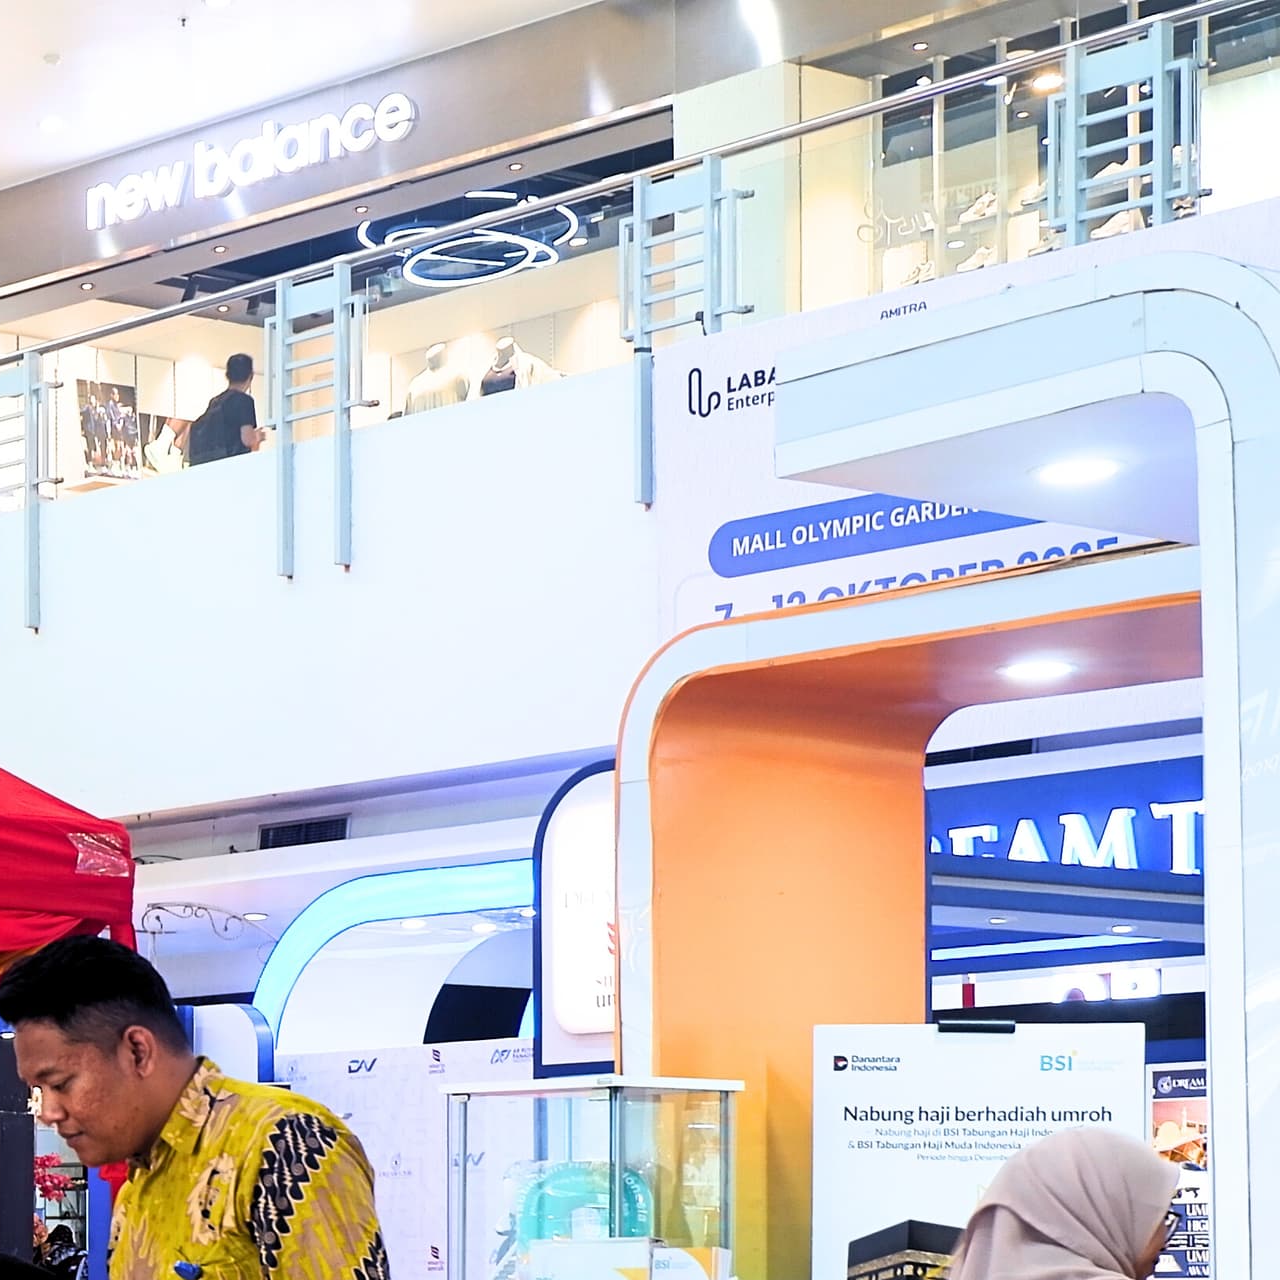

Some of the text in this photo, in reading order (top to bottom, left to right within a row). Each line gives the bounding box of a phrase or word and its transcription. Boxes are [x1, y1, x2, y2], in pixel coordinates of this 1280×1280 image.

[86, 91, 418, 231] new balance
[880, 301, 928, 320] AMITRA
[731, 529, 786, 557] MALL
[791, 510, 885, 546] OLYMPIC
[851, 1055, 901, 1065] Danantara
[851, 1063, 898, 1073] Indonesia
[1039, 1055, 1073, 1072] BSI
[843, 1105, 1113, 1126] Nabung haji berhadiah umroh
[875, 1127, 912, 1139] Nabung
[913, 1127, 931, 1138] haji
[943, 1128, 960, 1137] BSI
[962, 1127, 1008, 1139] Tabungan
[1010, 1127, 1031, 1139] Haji
[857, 1140, 874, 1149] BSI
[876, 1140, 922, 1151] Tabungan
[923, 1140, 943, 1151] Haji
[945, 1140, 972, 1149] Muda
[974, 1140, 1022, 1150] Indonesia
